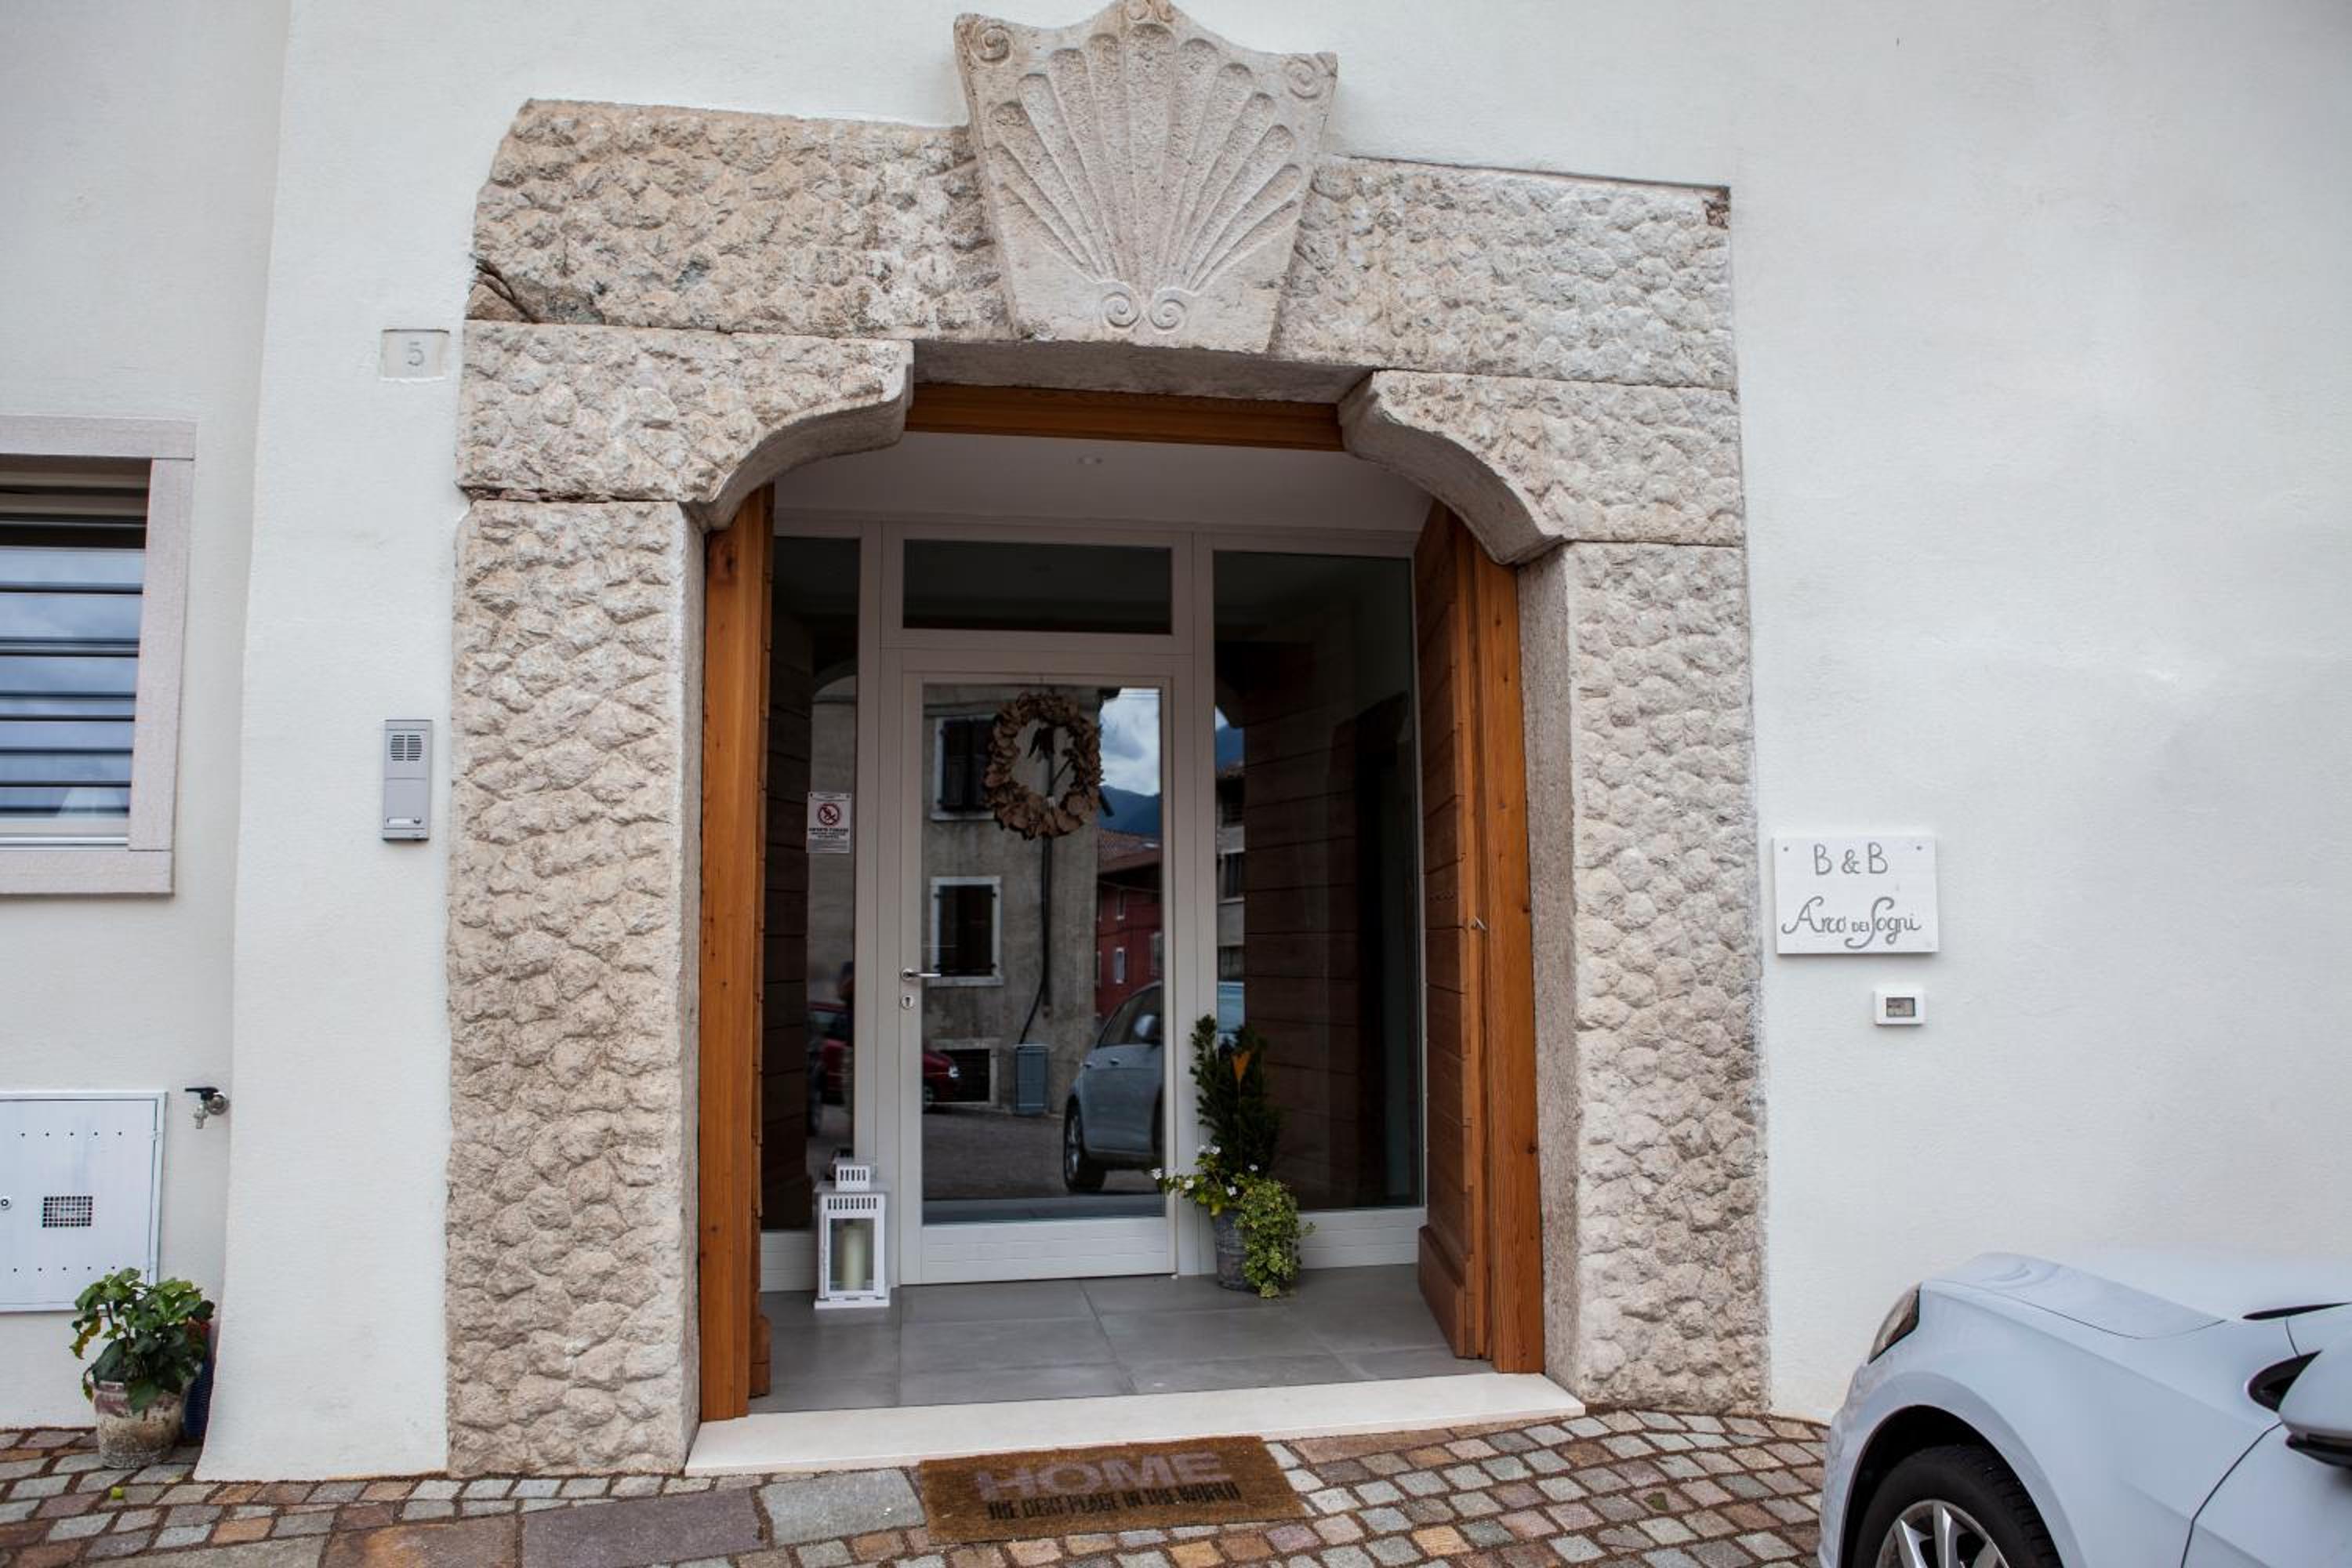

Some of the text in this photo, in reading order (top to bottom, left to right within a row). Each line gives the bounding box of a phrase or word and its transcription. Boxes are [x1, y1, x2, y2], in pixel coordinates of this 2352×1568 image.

[407, 340, 425, 367] 5
[1813, 841, 1889, 876] B & B
[1780, 895, 1847, 935] Arco
[1843, 895, 1922, 950] Sogni
[974, 1450, 1232, 1502] HOME
